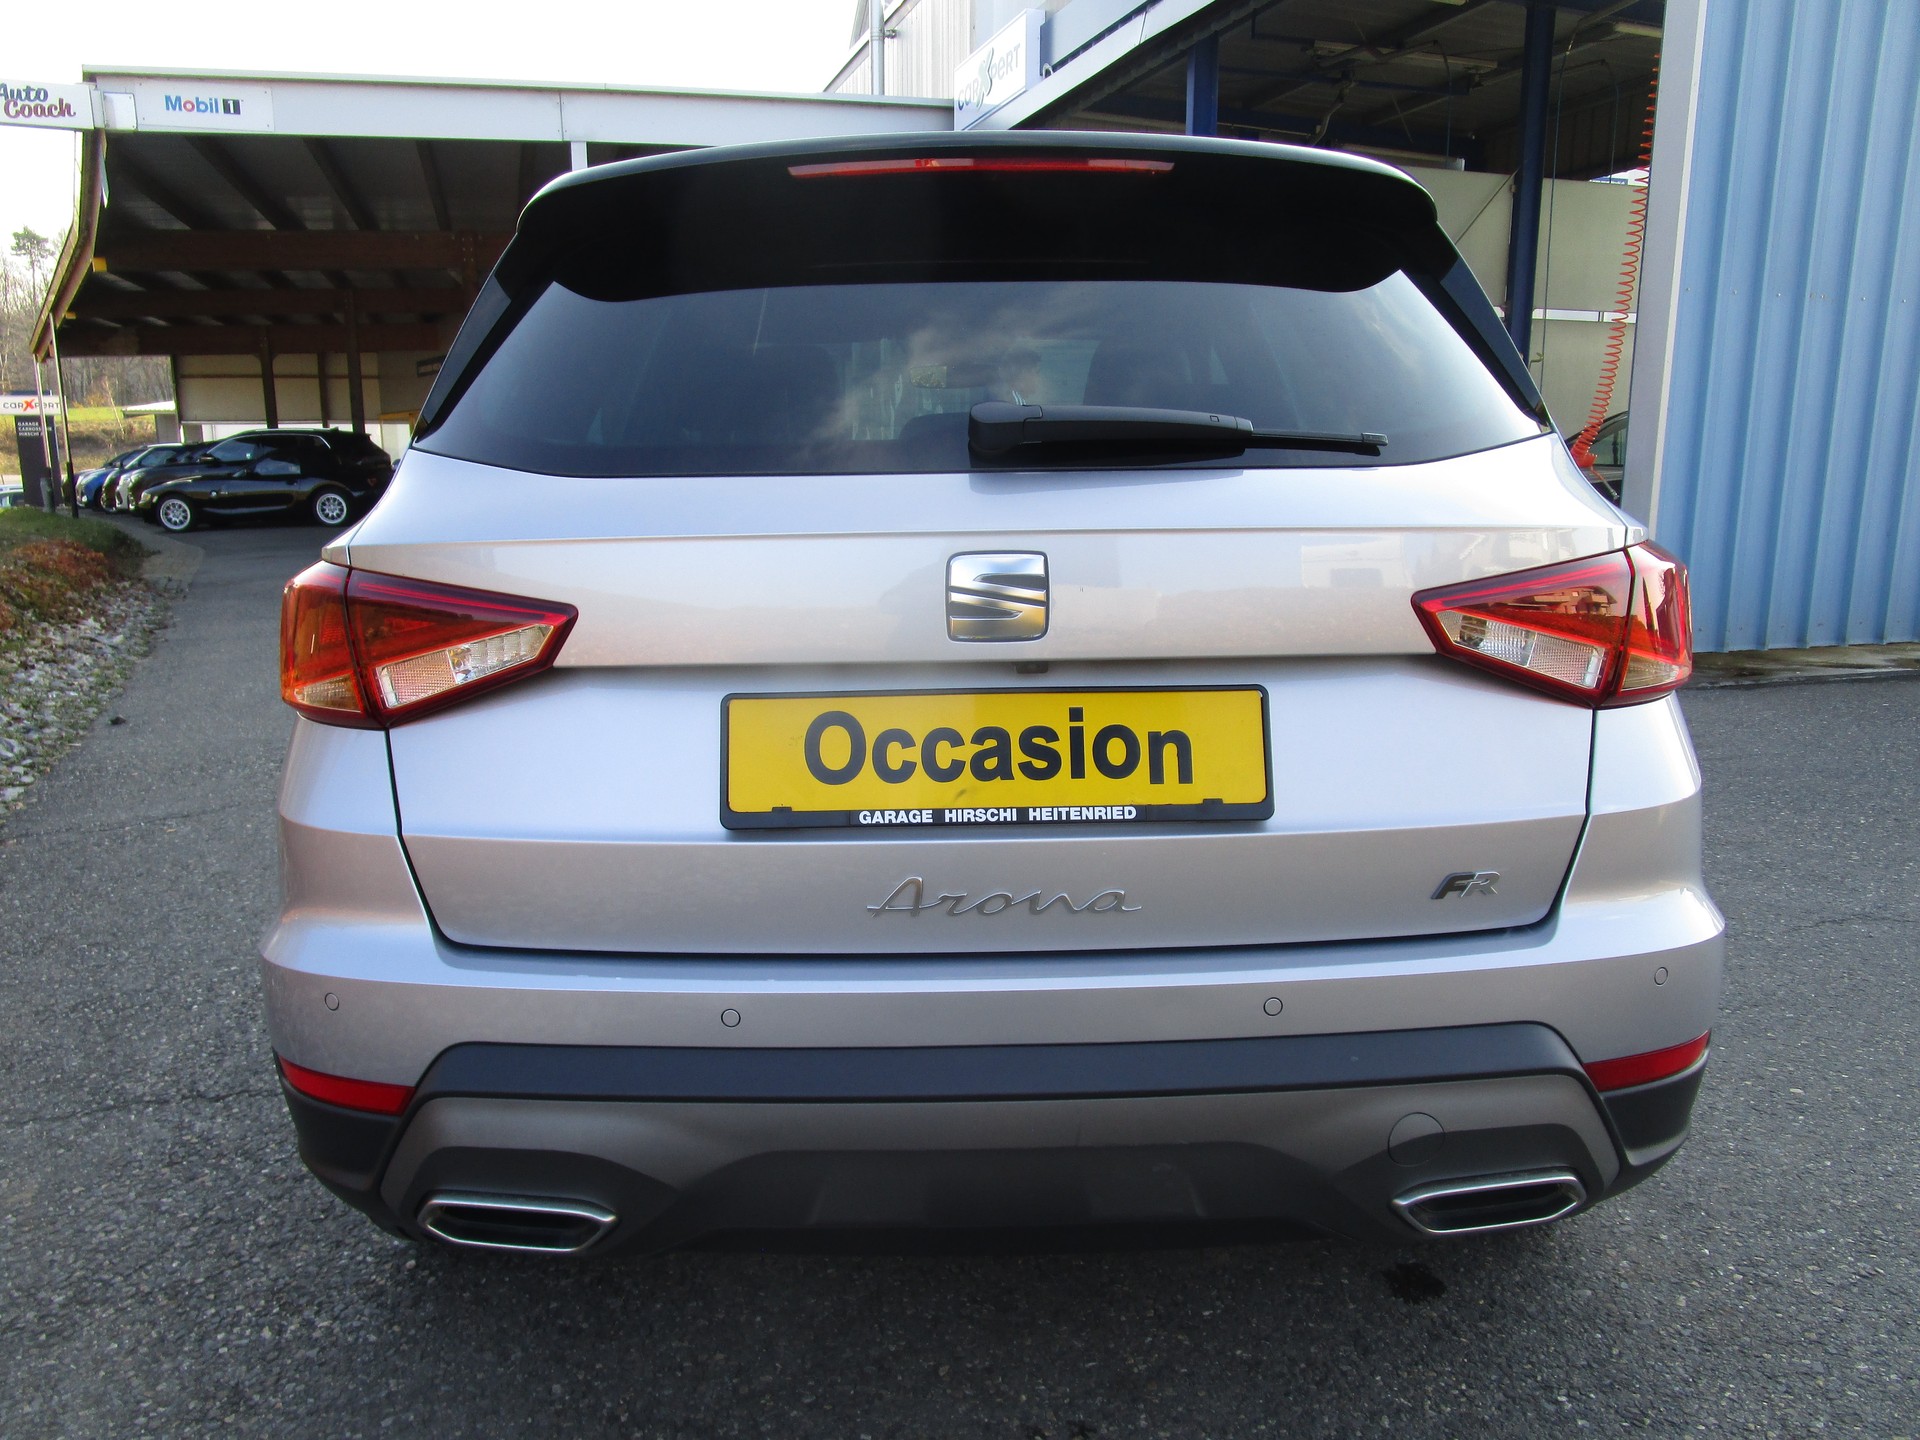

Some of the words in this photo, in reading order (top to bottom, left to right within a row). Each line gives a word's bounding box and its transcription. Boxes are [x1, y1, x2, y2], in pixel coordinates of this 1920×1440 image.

[0, 83, 49, 102] Auto
[4, 98, 77, 118] Coach
[164, 95, 220, 113] Mobil
[803, 706, 1194, 785] Occasion
[858, 809, 933, 824] GARAGE
[944, 808, 1017, 822] HIRSCHI
[1028, 806, 1137, 821] HEITENRIED
[1430, 871, 1500, 899] FR
[866, 876, 1143, 916] Arona
